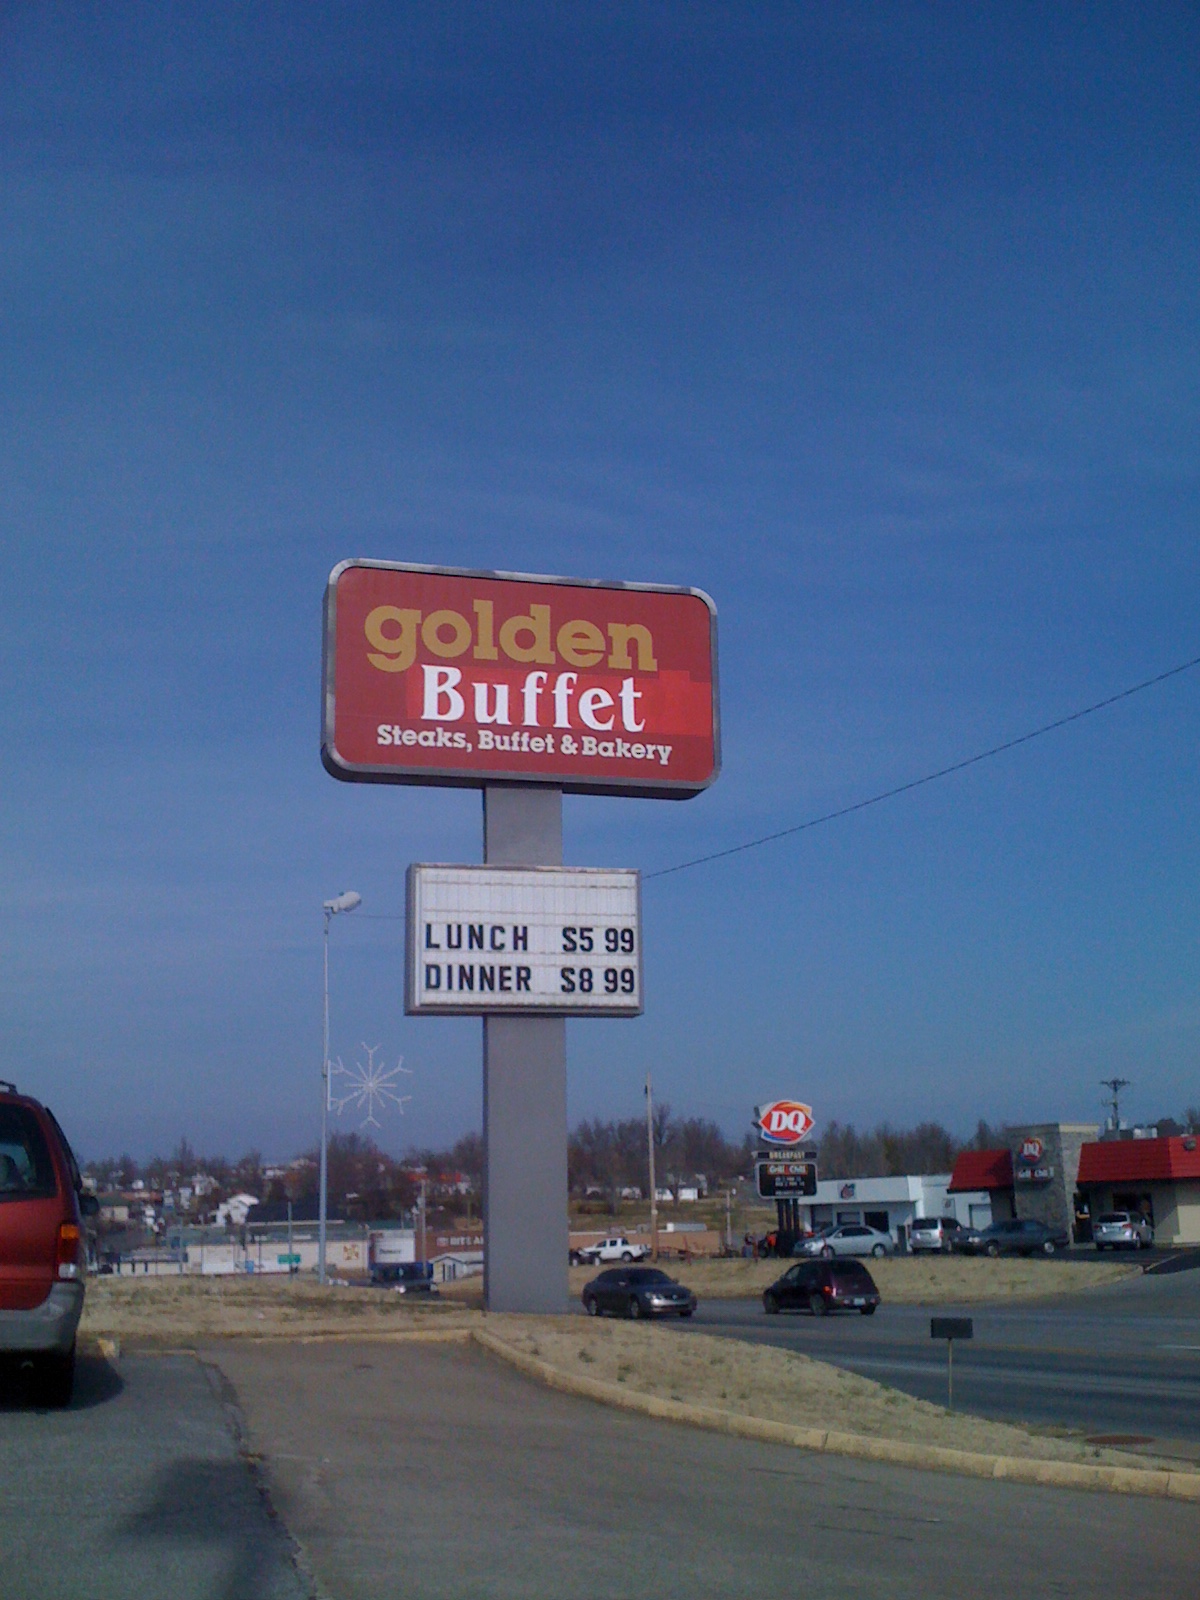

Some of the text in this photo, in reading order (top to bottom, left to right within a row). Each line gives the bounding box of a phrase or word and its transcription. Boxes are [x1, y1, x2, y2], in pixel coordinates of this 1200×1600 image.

[364, 599, 658, 673] golden
[420, 664, 646, 733] Buffet
[377, 724, 672, 765] Steaks, Buffet & Bakery
[425, 923, 528, 951] LUNCH
[604, 927, 635, 953] 99
[425, 964, 531, 991] DINNER
[603, 968, 635, 994] 99
[770, 1110, 807, 1135] DQ
